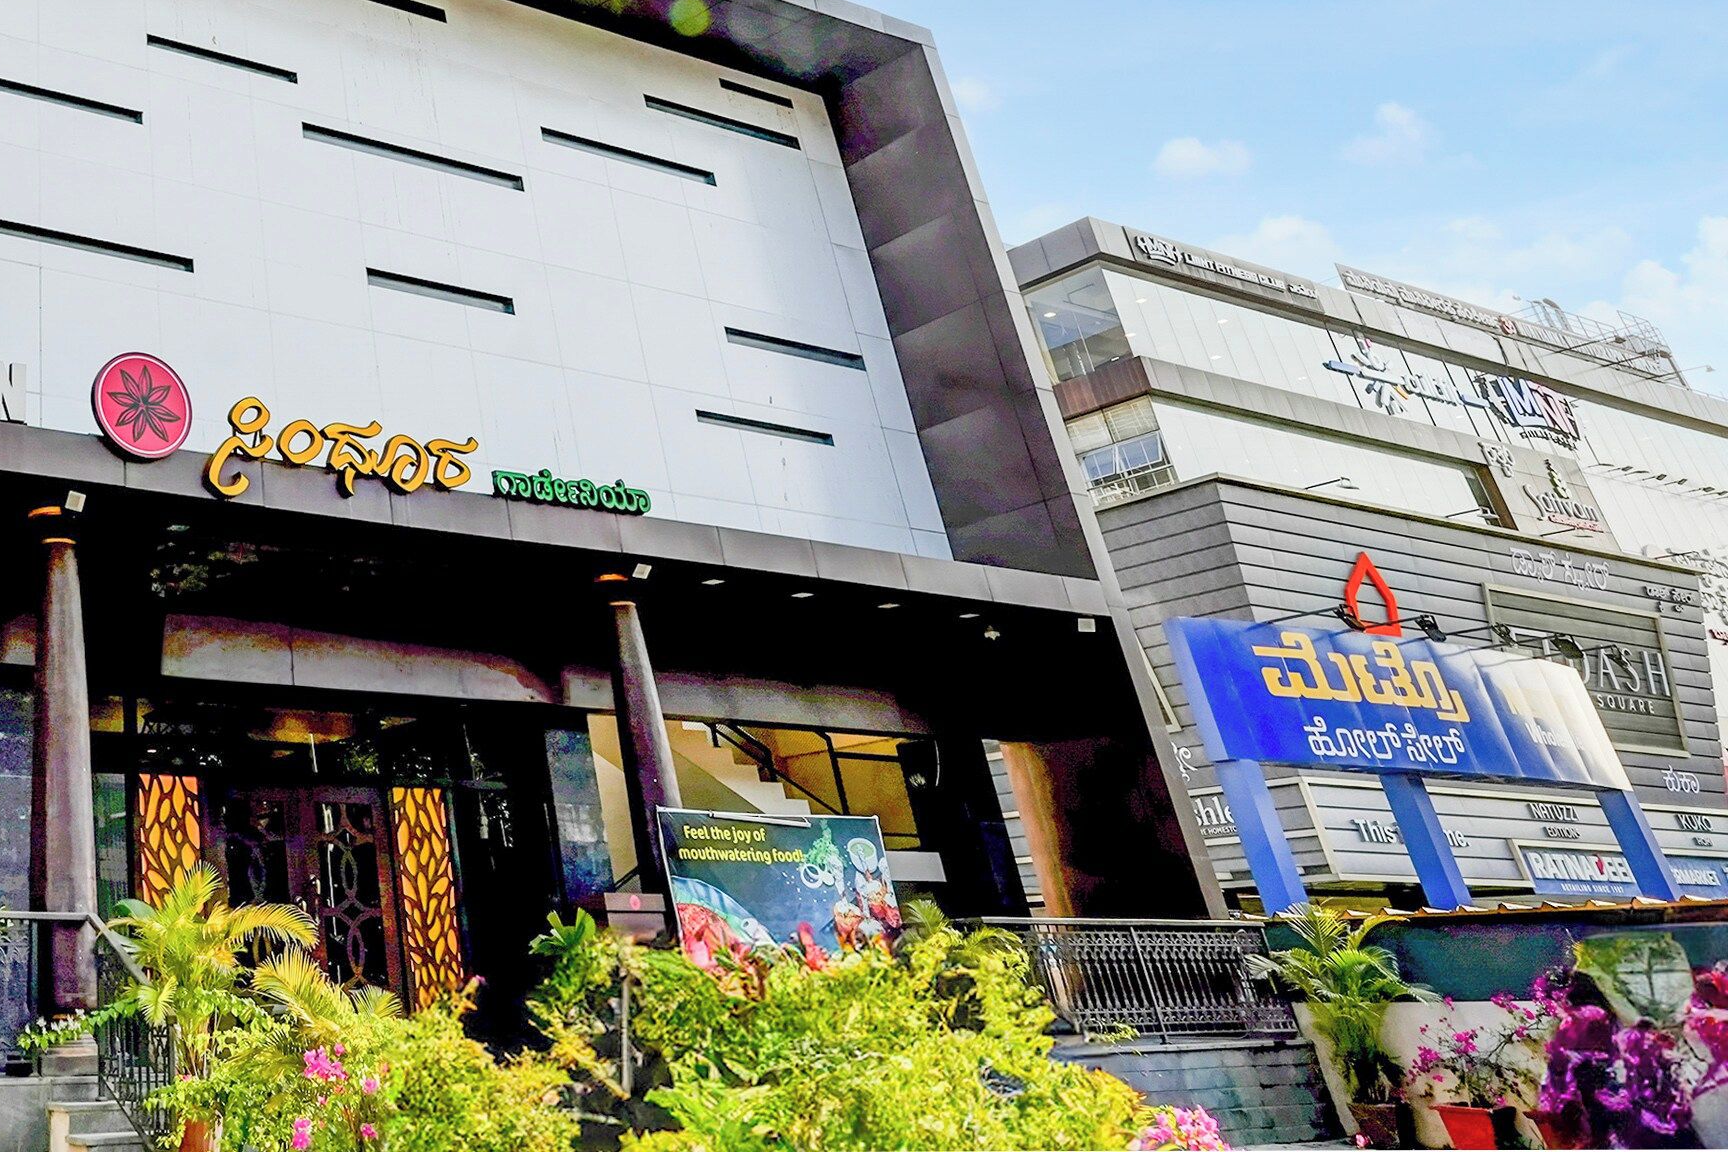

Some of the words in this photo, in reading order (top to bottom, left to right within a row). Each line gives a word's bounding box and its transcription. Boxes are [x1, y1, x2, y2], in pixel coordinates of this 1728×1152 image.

[1597, 694, 1655, 714] SQUARE
[1529, 802, 1580, 821] NATUZZI
[684, 824, 708, 840] Feel
[711, 826, 730, 841] the
[731, 827, 751, 845] joy
[752, 827, 766, 842] of
[1355, 818, 1397, 844] This
[679, 846, 771, 864] mouthwatering
[773, 848, 804, 863] food!
